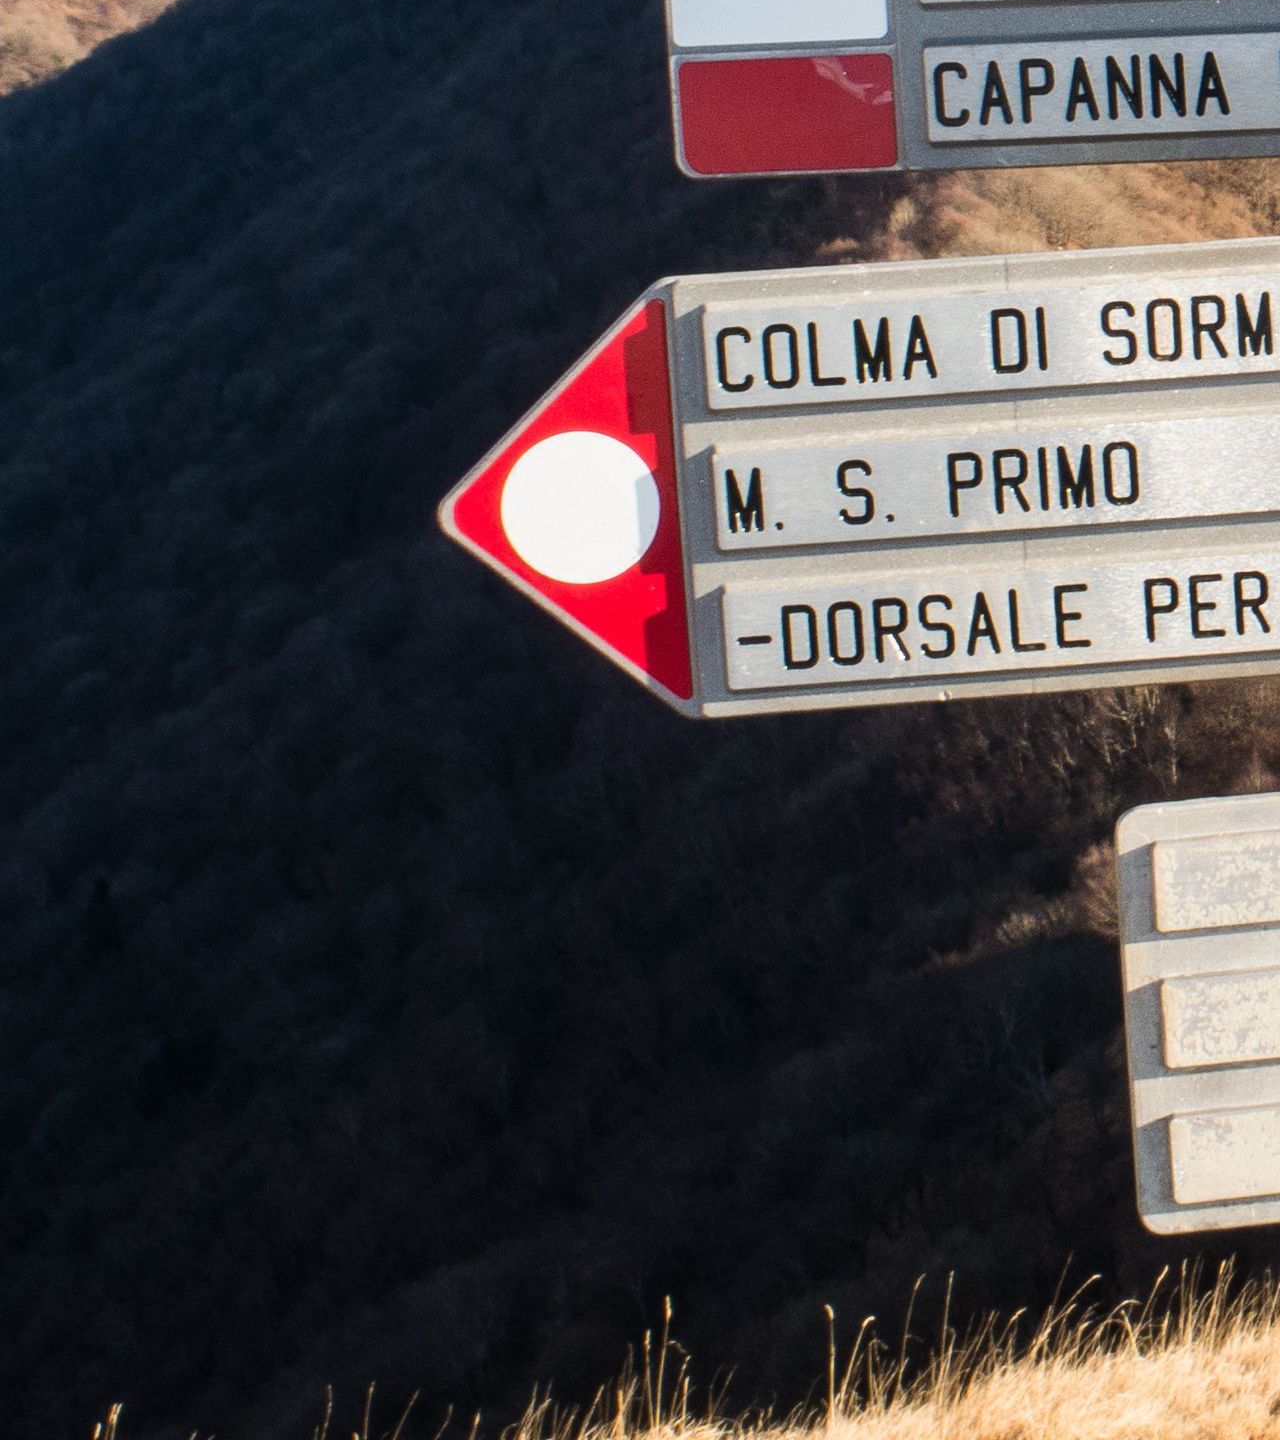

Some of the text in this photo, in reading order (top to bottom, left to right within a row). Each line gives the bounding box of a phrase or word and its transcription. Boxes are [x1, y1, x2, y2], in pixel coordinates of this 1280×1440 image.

[933, 51, 1229, 128] CAPANNA
[716, 315, 937, 393] COLMA
[990, 306, 1047, 374] DI
[725, 467, 783, 534] M.
[837, 459, 894, 525] S.
[947, 441, 1139, 518] PRIMO
[1144, 571, 1270, 643] PER
